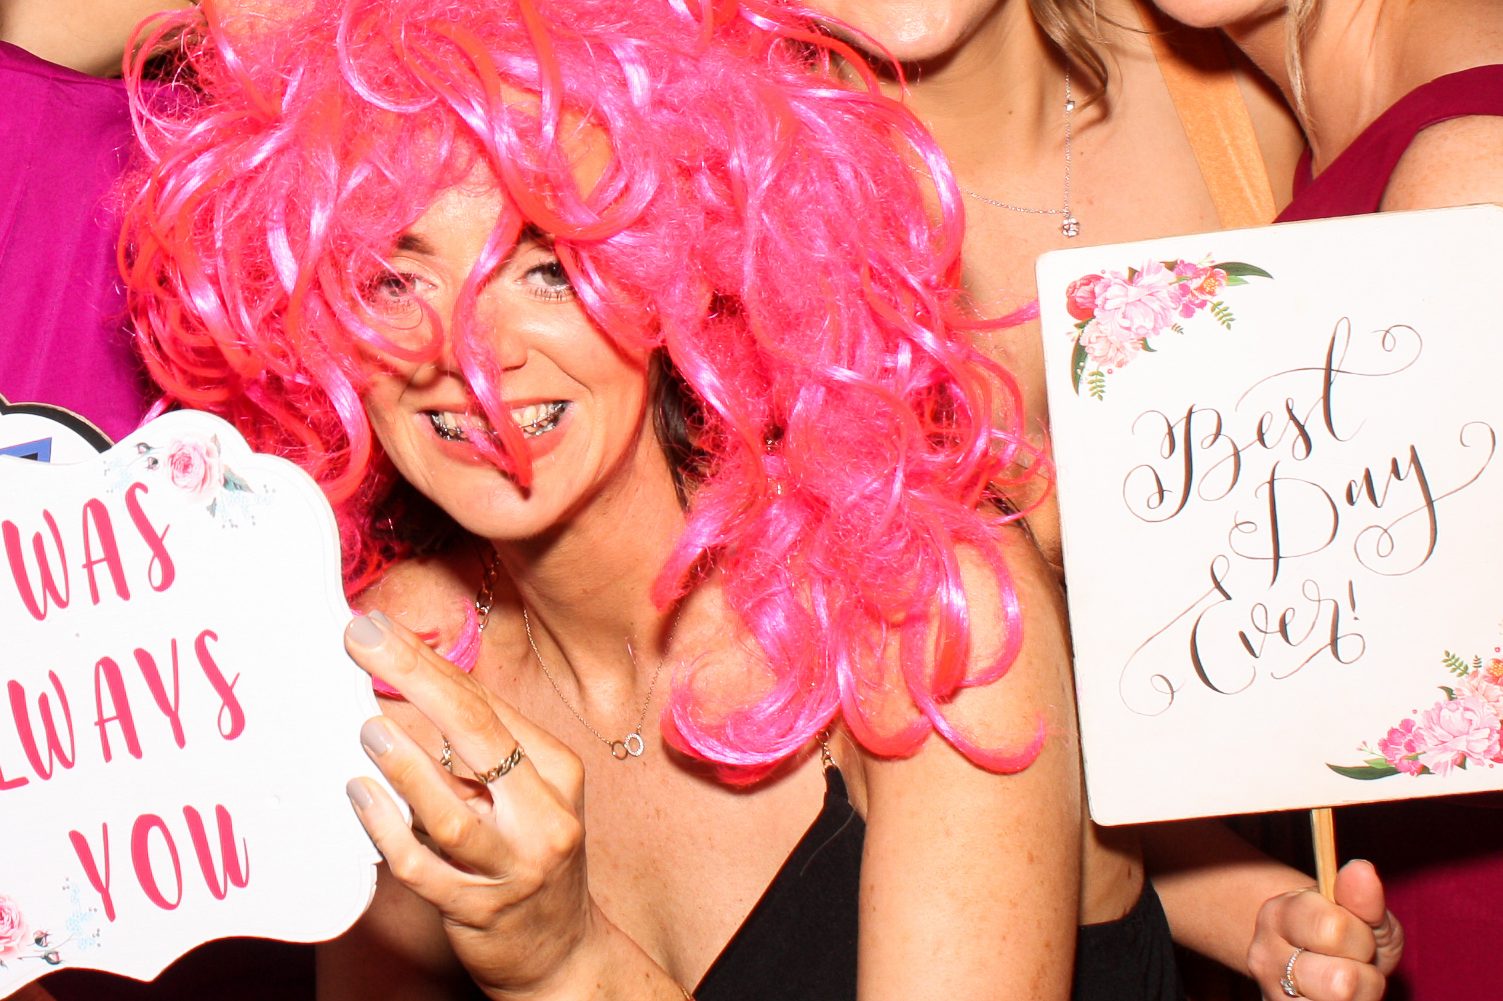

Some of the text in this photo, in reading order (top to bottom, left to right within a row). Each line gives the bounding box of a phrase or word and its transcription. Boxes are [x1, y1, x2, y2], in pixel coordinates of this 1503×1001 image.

[1123, 316, 1422, 523] Best
[2, 481, 176, 622] WAS
[1229, 421, 1496, 588] Day
[1118, 554, 1366, 717] Ever!
[69, 804, 250, 922] YOU
